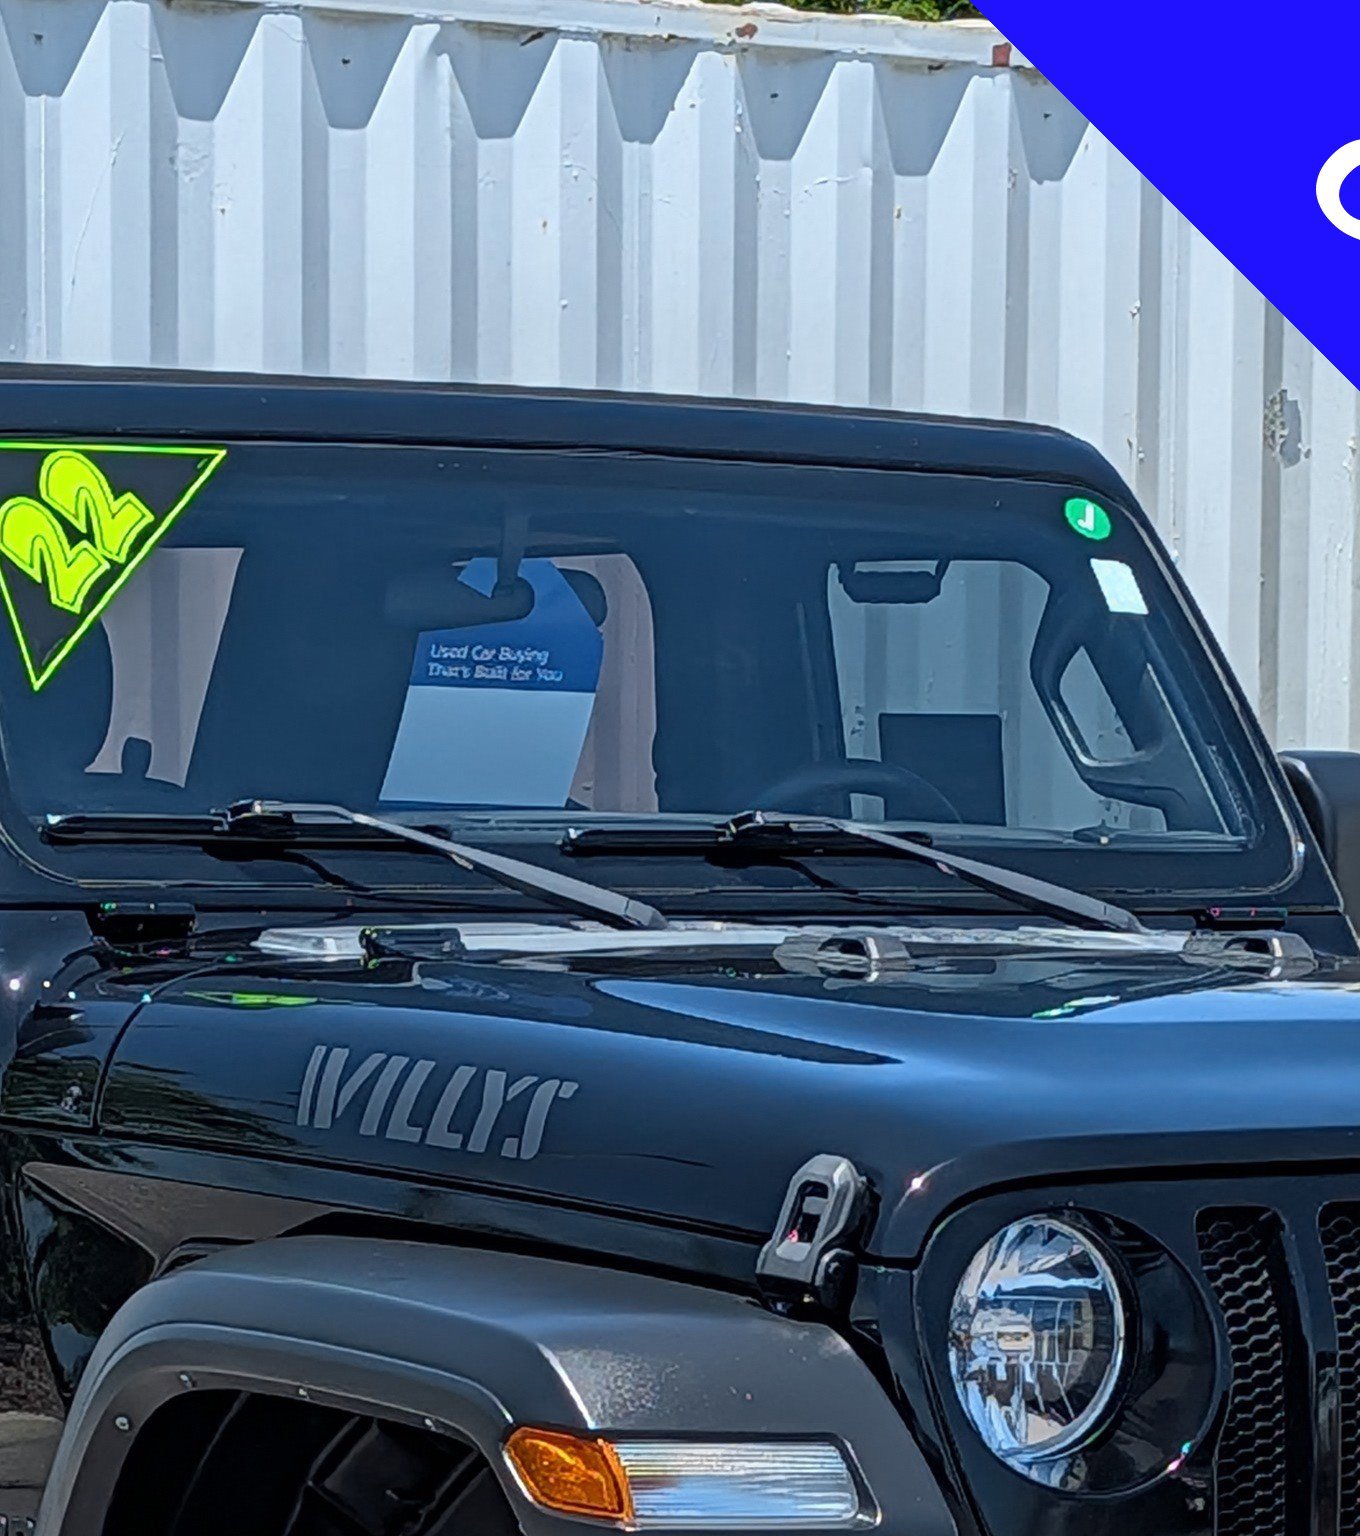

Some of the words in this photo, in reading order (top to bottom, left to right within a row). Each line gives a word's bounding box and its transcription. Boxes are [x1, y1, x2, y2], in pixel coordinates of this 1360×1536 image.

[430, 644, 469, 660] Used
[471, 645, 497, 661] Car
[498, 646, 550, 666] Buying
[427, 662, 471, 679] That's
[473, 664, 509, 681] Built
[510, 666, 532, 682] for
[536, 668, 563, 682] You
[296, 1044, 579, 1161] WILLYS
